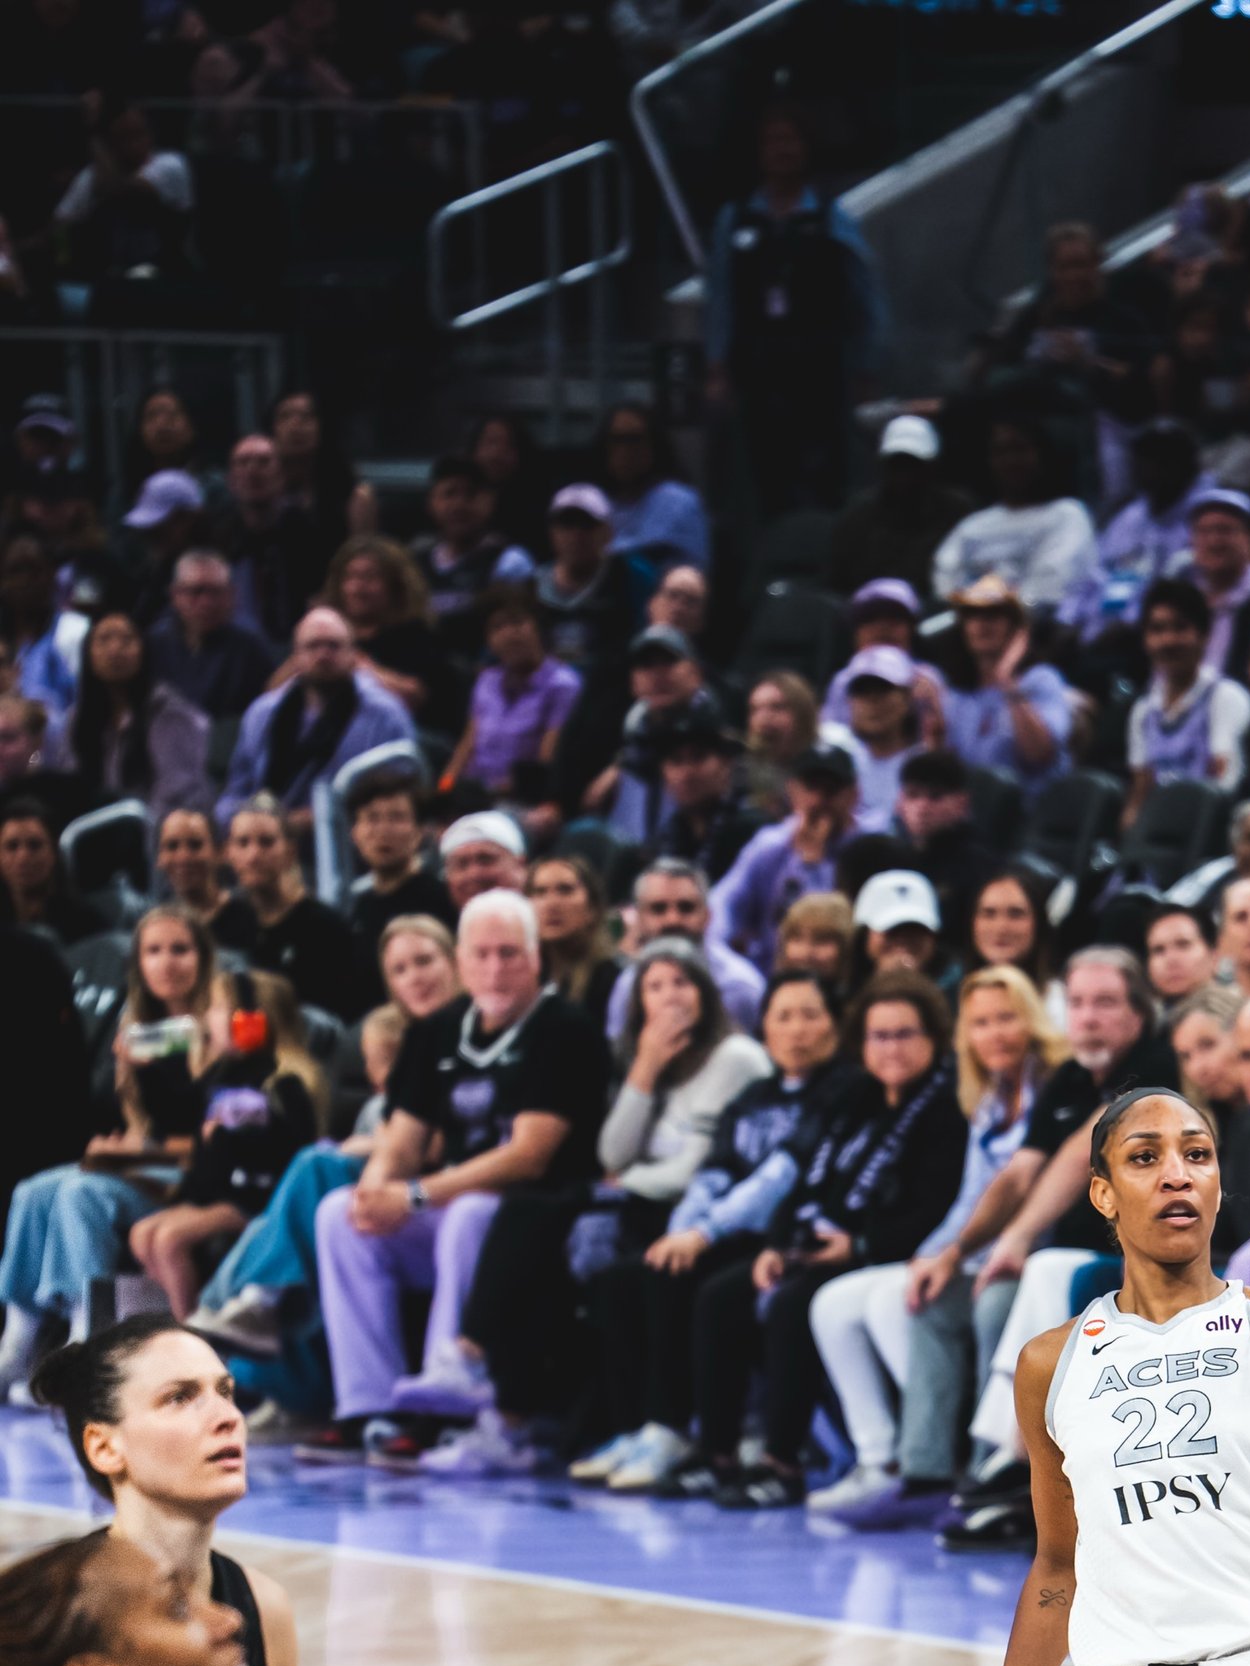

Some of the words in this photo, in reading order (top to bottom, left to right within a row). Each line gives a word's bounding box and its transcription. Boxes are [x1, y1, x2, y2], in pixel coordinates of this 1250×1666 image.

[1205, 1314, 1243, 1335] ally
[1089, 1347, 1239, 1399] ACES
[1112, 1390, 1218, 1467] 22
[1112, 1472, 1232, 1526] IPSY
